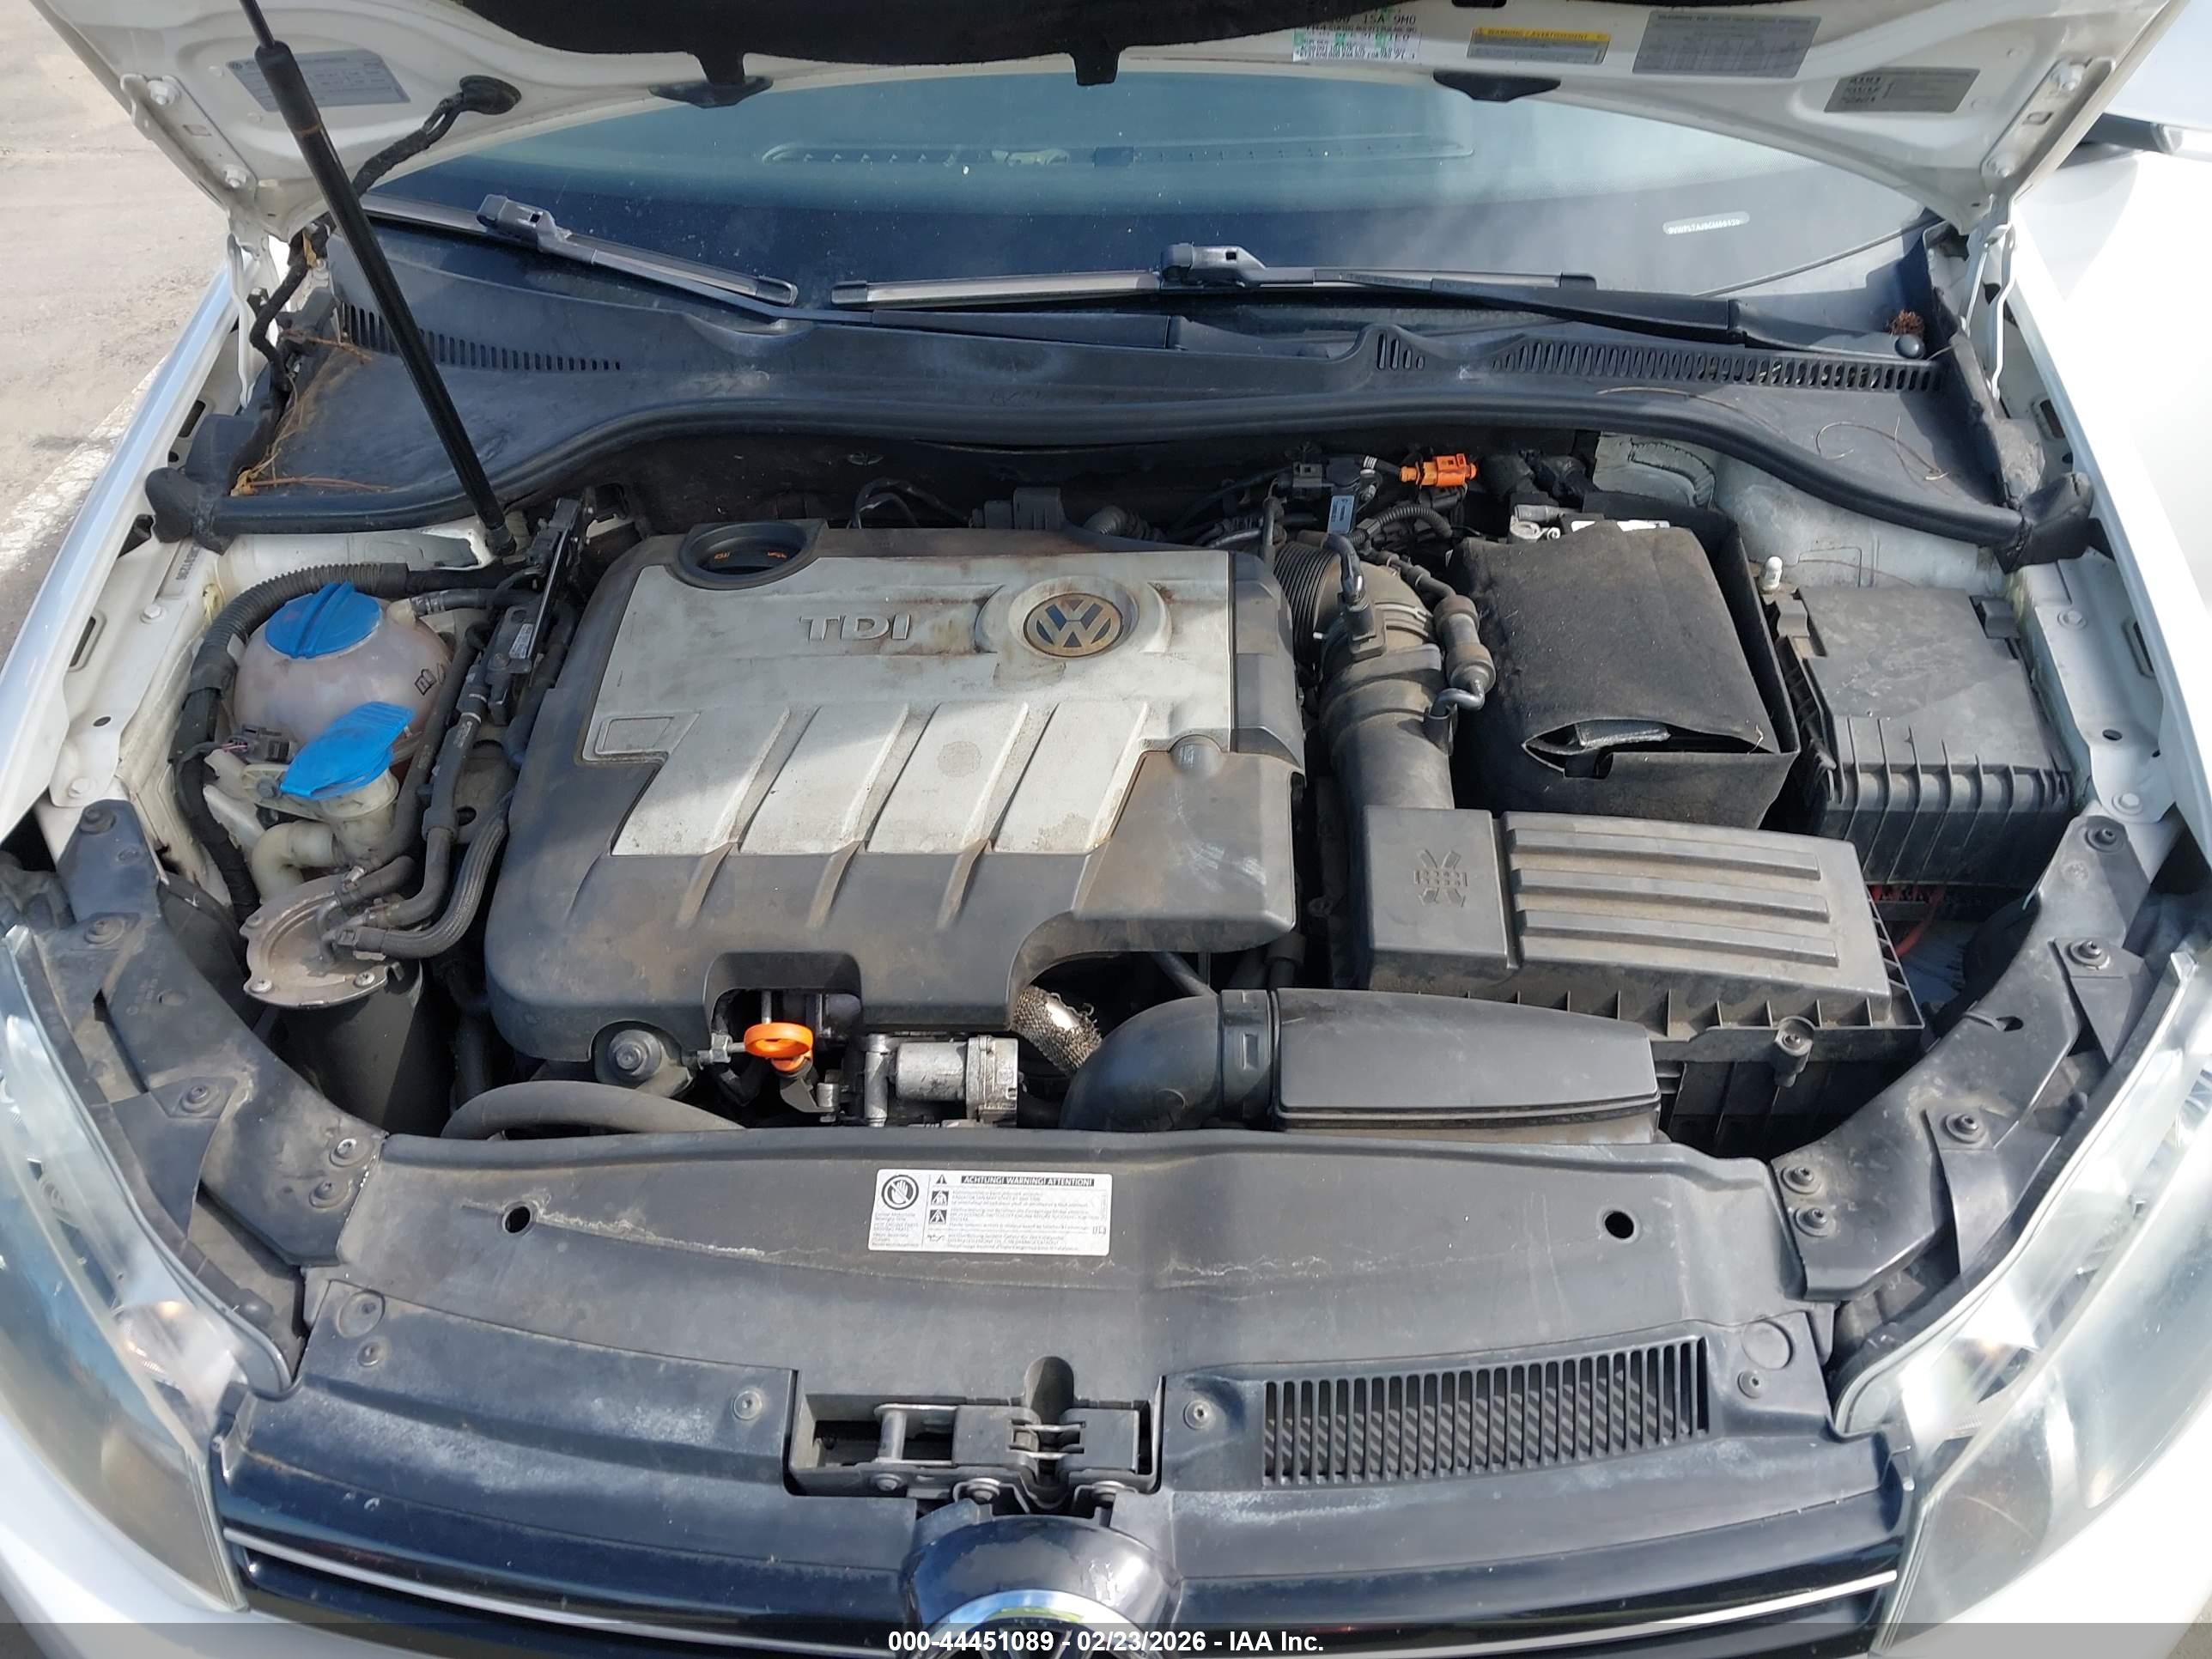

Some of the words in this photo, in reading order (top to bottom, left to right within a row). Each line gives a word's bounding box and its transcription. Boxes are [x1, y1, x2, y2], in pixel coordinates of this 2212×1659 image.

[799, 613, 912, 641] TDI
[1006, 1176, 1046, 1186] WARNING!
[1048, 1178, 1094, 1188] ATTENTION!
